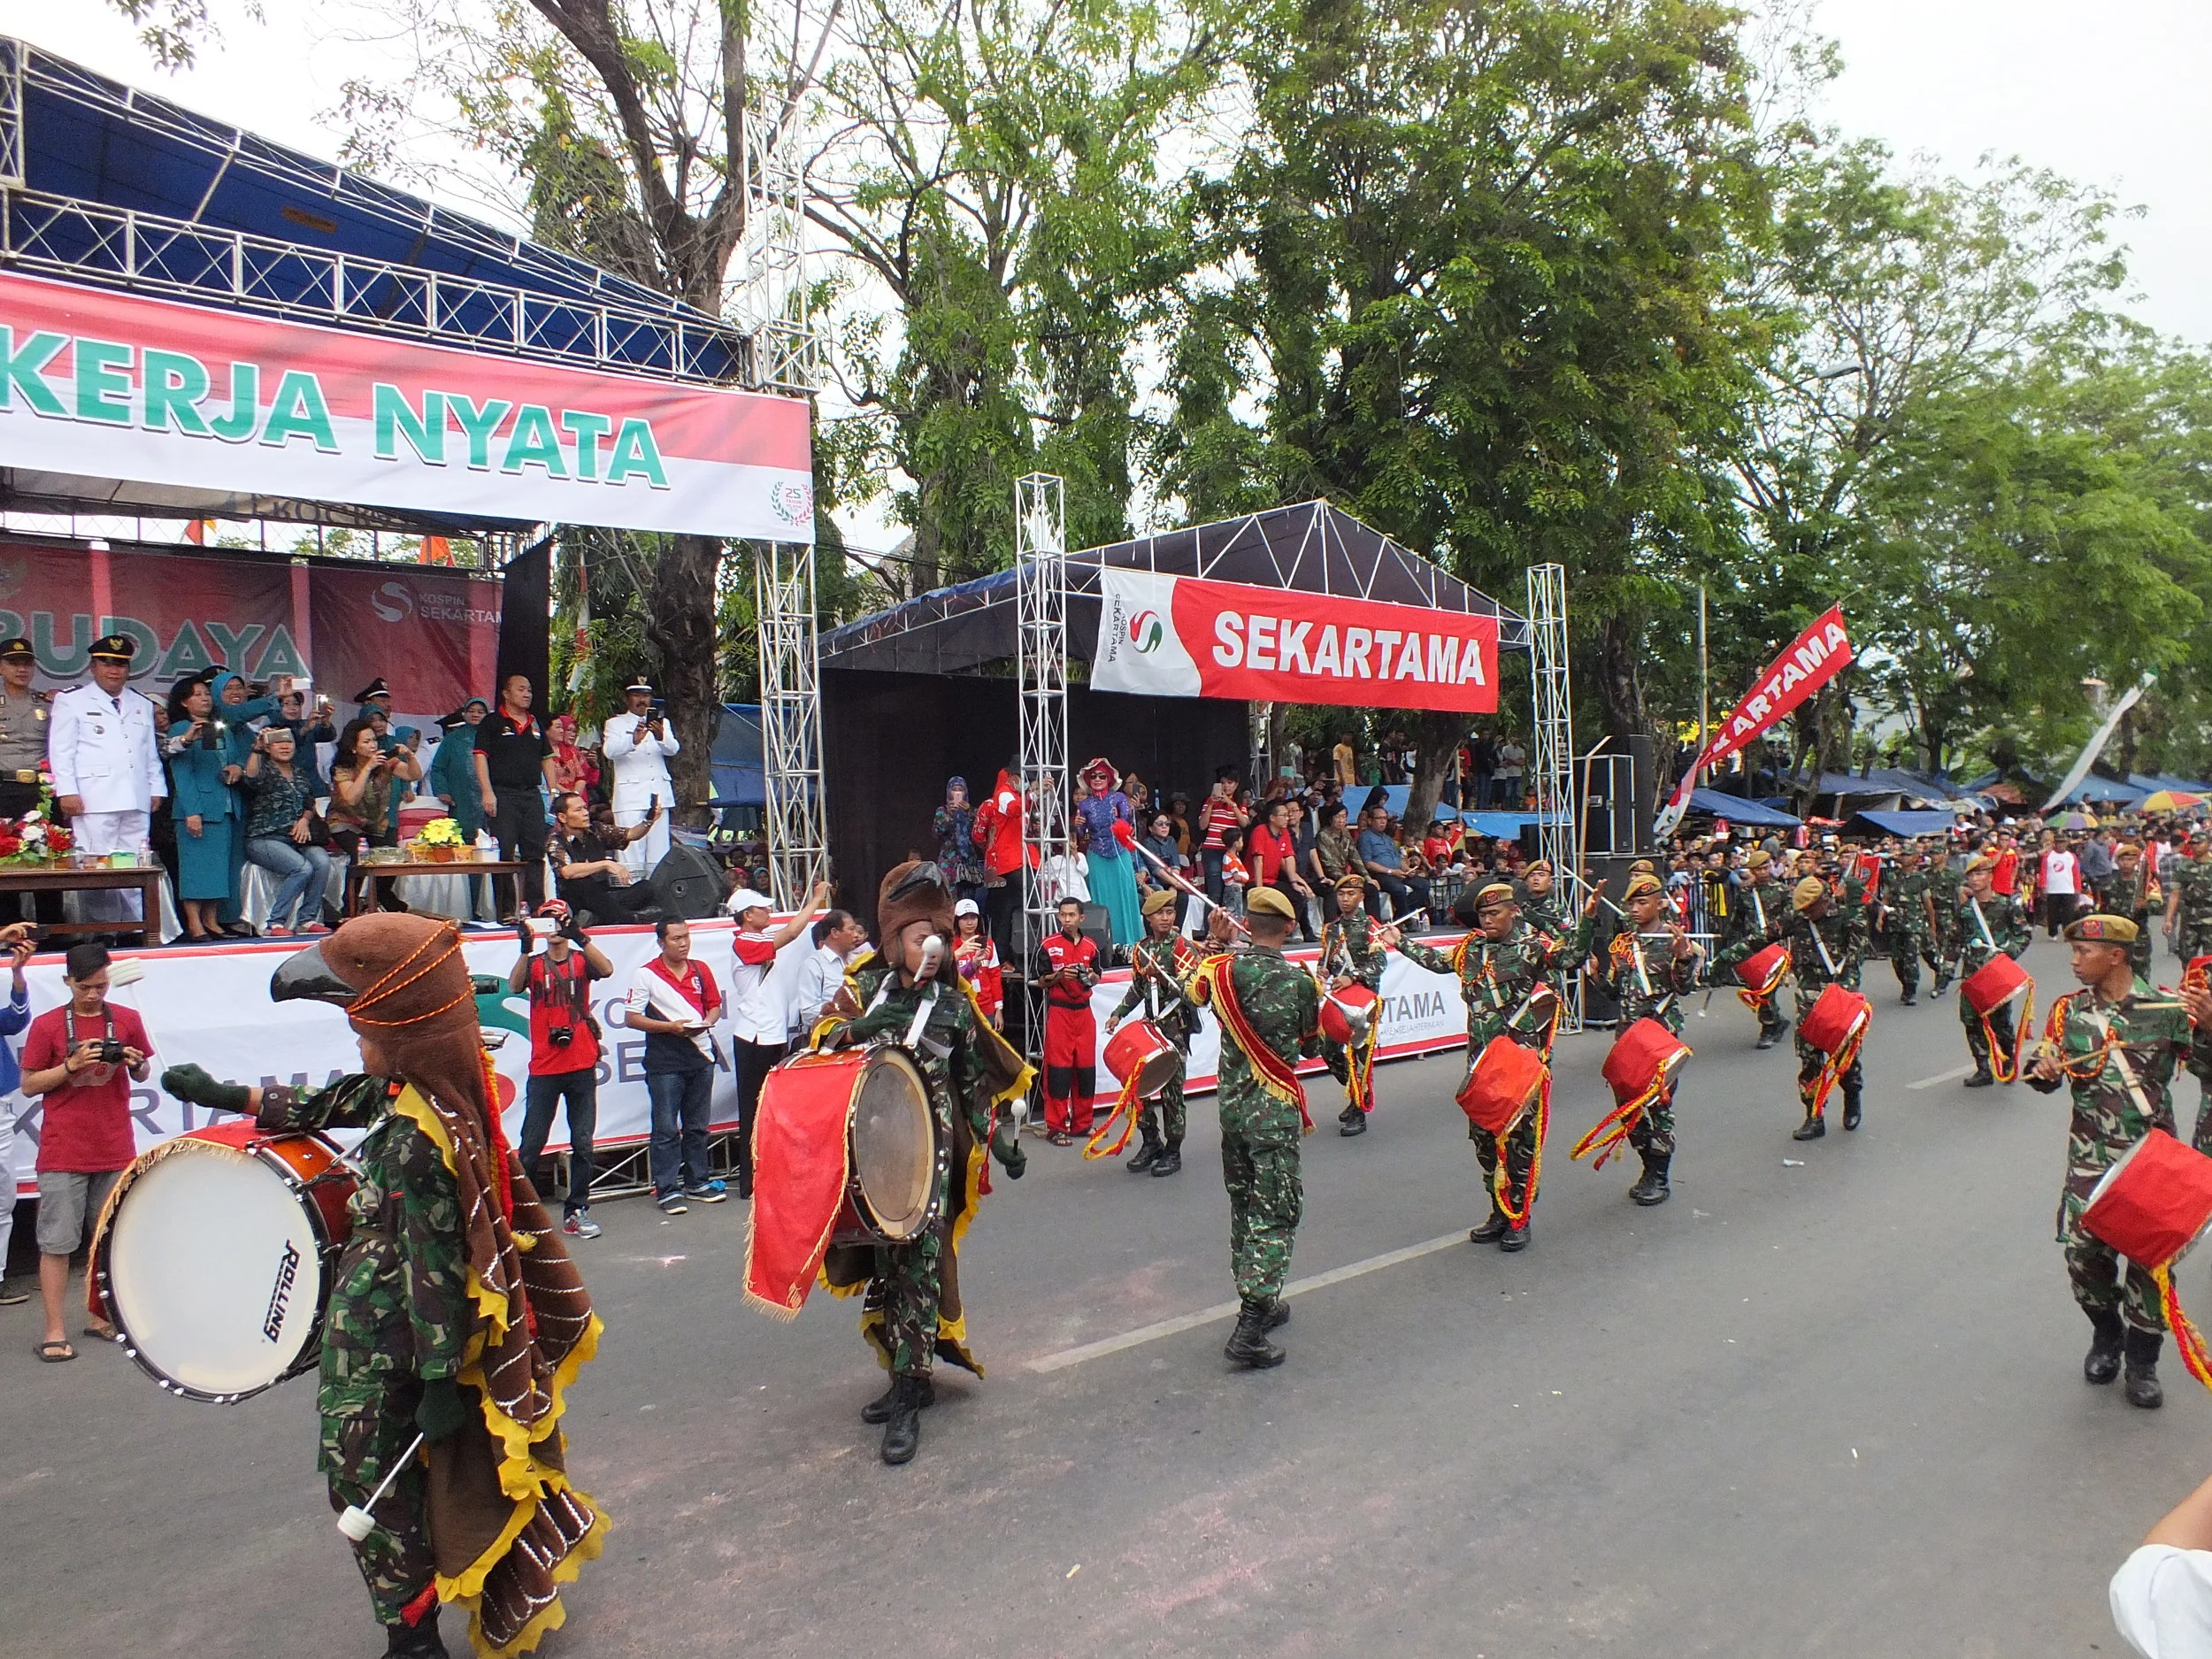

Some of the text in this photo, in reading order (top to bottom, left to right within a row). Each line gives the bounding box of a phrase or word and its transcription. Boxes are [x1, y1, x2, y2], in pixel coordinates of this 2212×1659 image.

[0, 324, 671, 490] KERJA NYATA
[785, 488, 802, 499] 25
[419, 593, 465, 606] KOSPIN
[1118, 613, 1127, 645] OSPIN
[1212, 611, 1486, 686] SEKARTAMA
[1379, 991, 1446, 1024] TAMA
[264, 1239, 301, 1343] ROLLING
